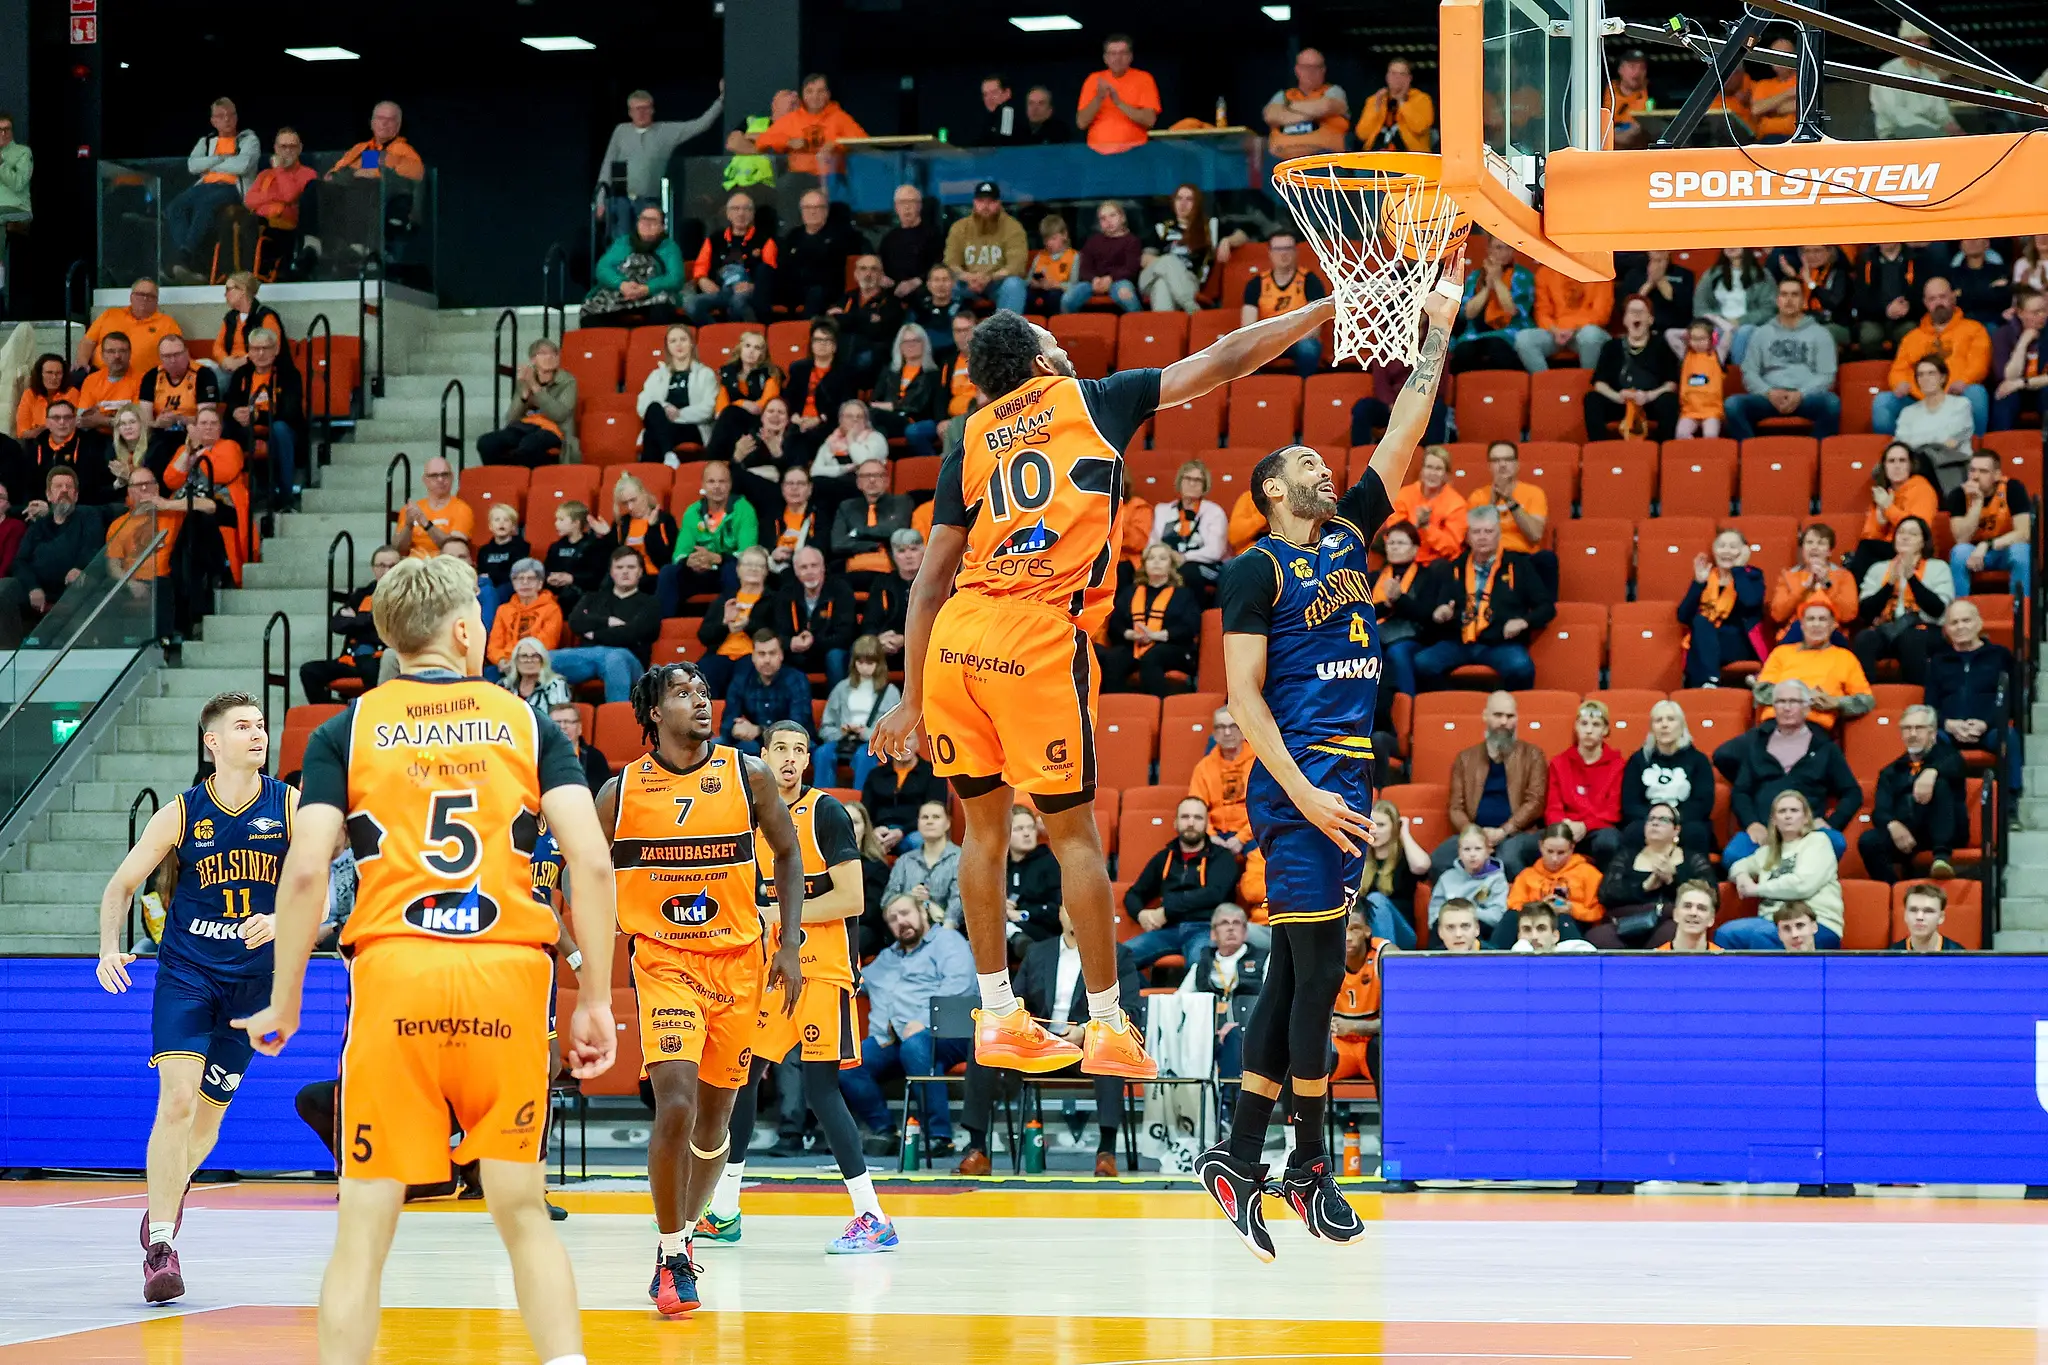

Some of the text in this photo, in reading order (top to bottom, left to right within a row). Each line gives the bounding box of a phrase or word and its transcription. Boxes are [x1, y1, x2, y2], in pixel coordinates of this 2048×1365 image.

[963, 244, 1003, 265] GAP
[987, 448, 1056, 523] 10
[1349, 611, 1370, 648] 4
[939, 648, 1026, 678] Terveystalo
[376, 721, 514, 748] SAJANTILA
[927, 734, 956, 764] 10
[673, 797, 695, 826] 7
[195, 840, 215, 848] tiketti
[420, 788, 483, 879] 5
[640, 842, 737, 861] KARHUBASKET
[196, 849, 278, 889] HELSINKI
[222, 887, 252, 919] 11
[188, 917, 240, 941] UKK
[394, 1018, 512, 1039] Terveystalo
[652, 1019, 682, 1029] Säte
[352, 1123, 372, 1163] 5
